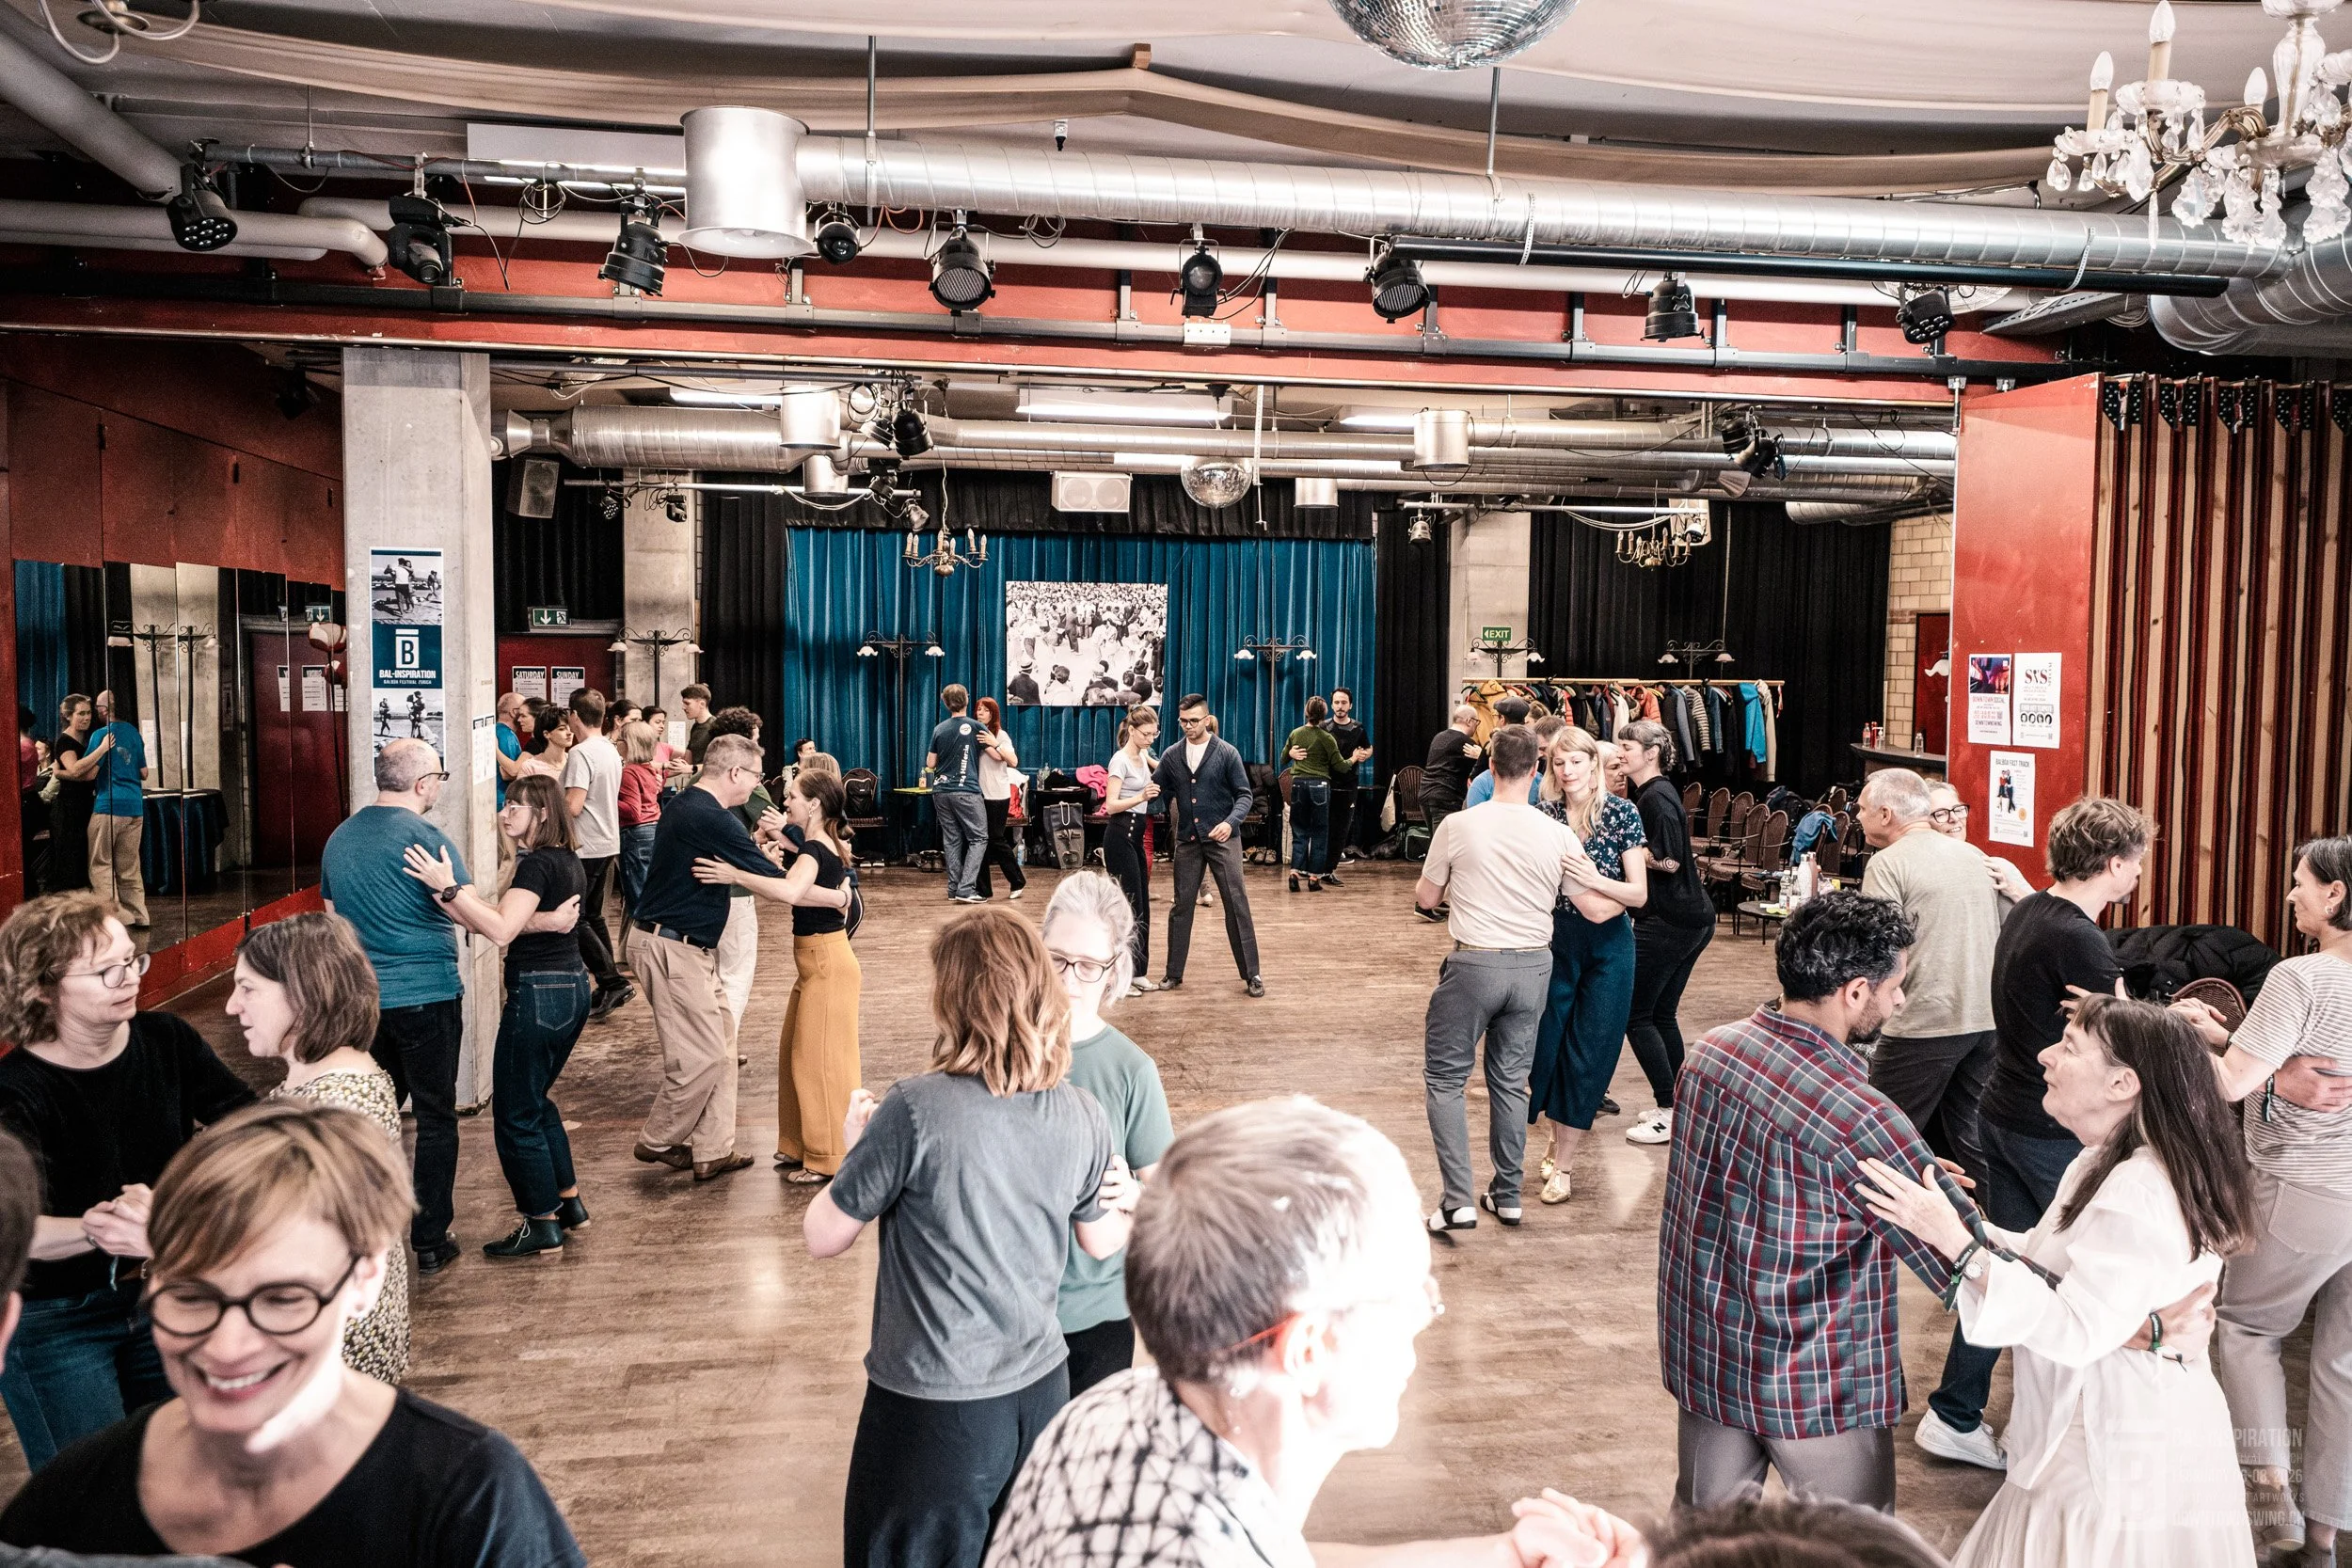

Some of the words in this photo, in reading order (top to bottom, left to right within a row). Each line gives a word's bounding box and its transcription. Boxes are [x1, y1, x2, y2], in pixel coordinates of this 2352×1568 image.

[1489, 629, 1510, 639] EXIT
[402, 640, 415, 665] B
[379, 670, 437, 679] BAL-INSPIRATION
[516, 671, 545, 679] SATURDAY
[556, 671, 580, 679] SUNDAY
[1652, 1122, 1667, 1133] N
